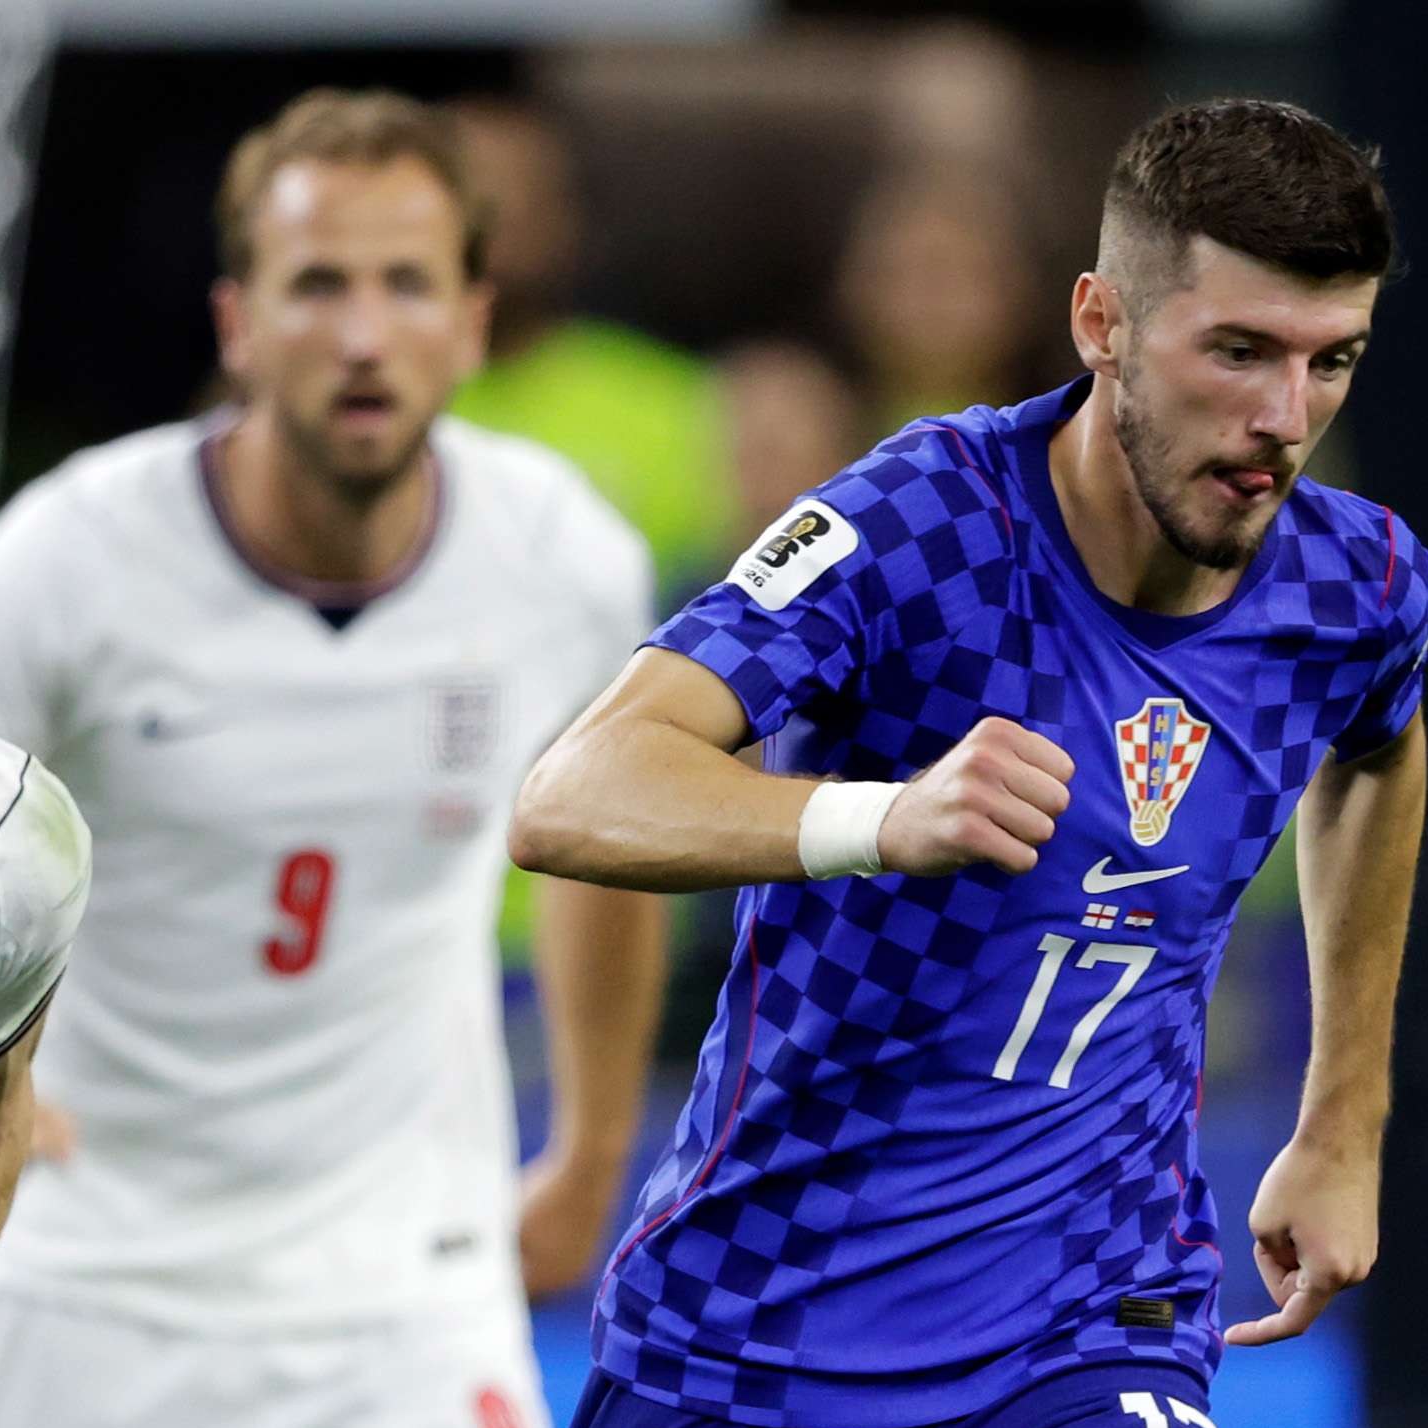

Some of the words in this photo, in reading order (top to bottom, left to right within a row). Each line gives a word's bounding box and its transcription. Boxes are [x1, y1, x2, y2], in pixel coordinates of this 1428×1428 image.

[1150, 714, 1170, 787] HNS
[263, 849, 336, 977] 9
[991, 932, 1157, 1090] 17
